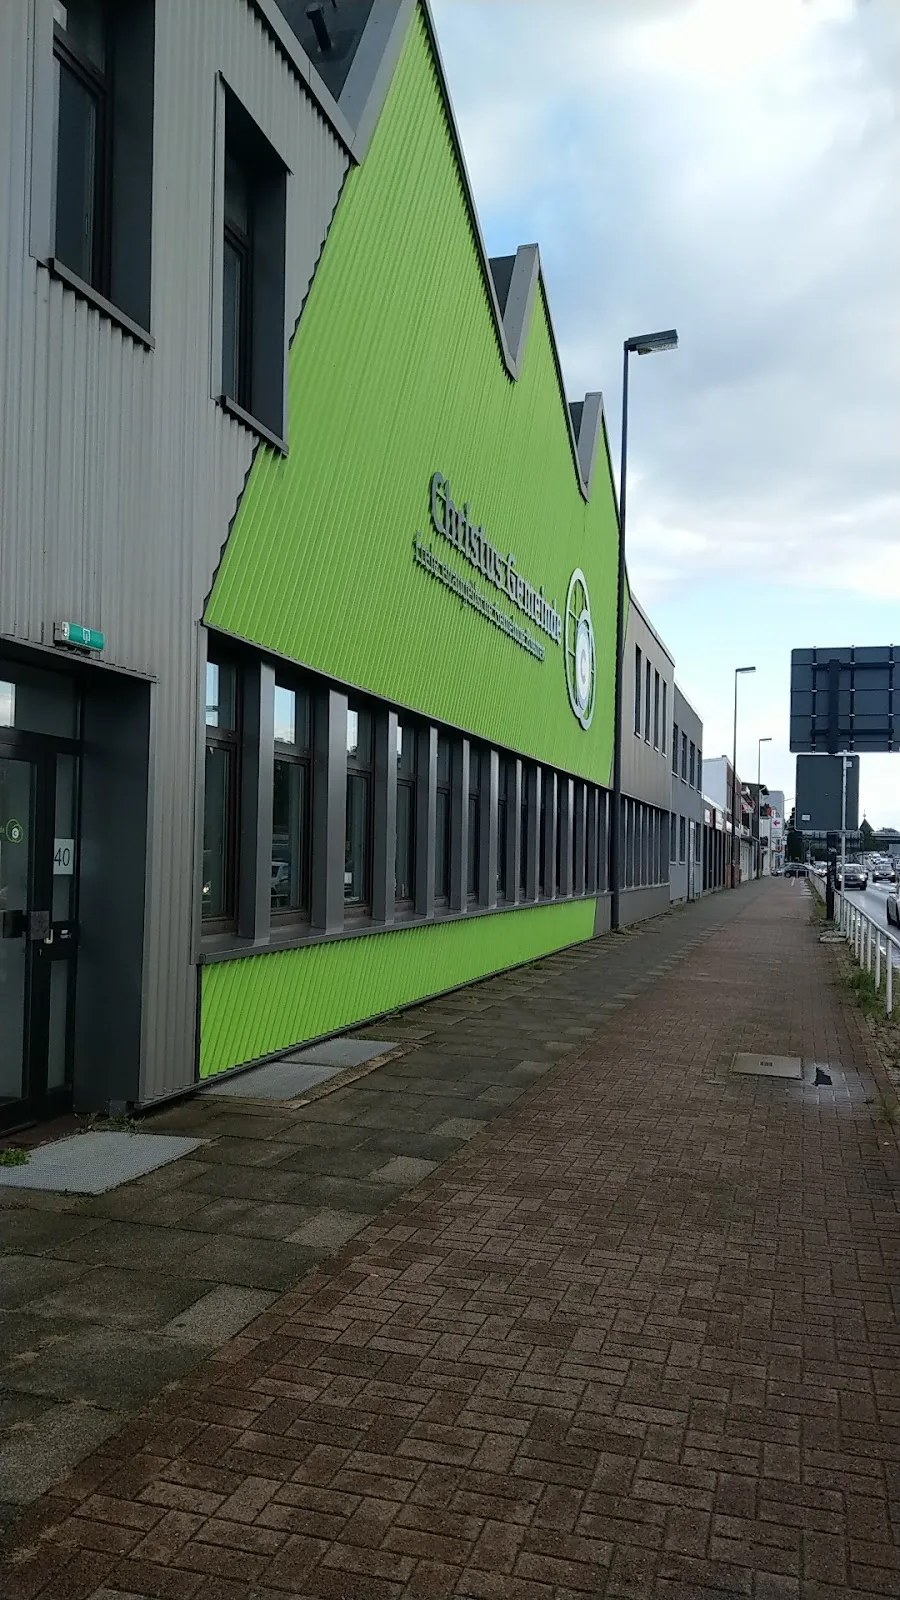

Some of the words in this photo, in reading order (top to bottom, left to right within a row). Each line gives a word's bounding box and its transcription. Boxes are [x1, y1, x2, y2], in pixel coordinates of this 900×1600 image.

[431, 471, 503, 590] Christus
[506, 553, 562, 645] Gemeinde
[54, 848, 70, 866] 40
